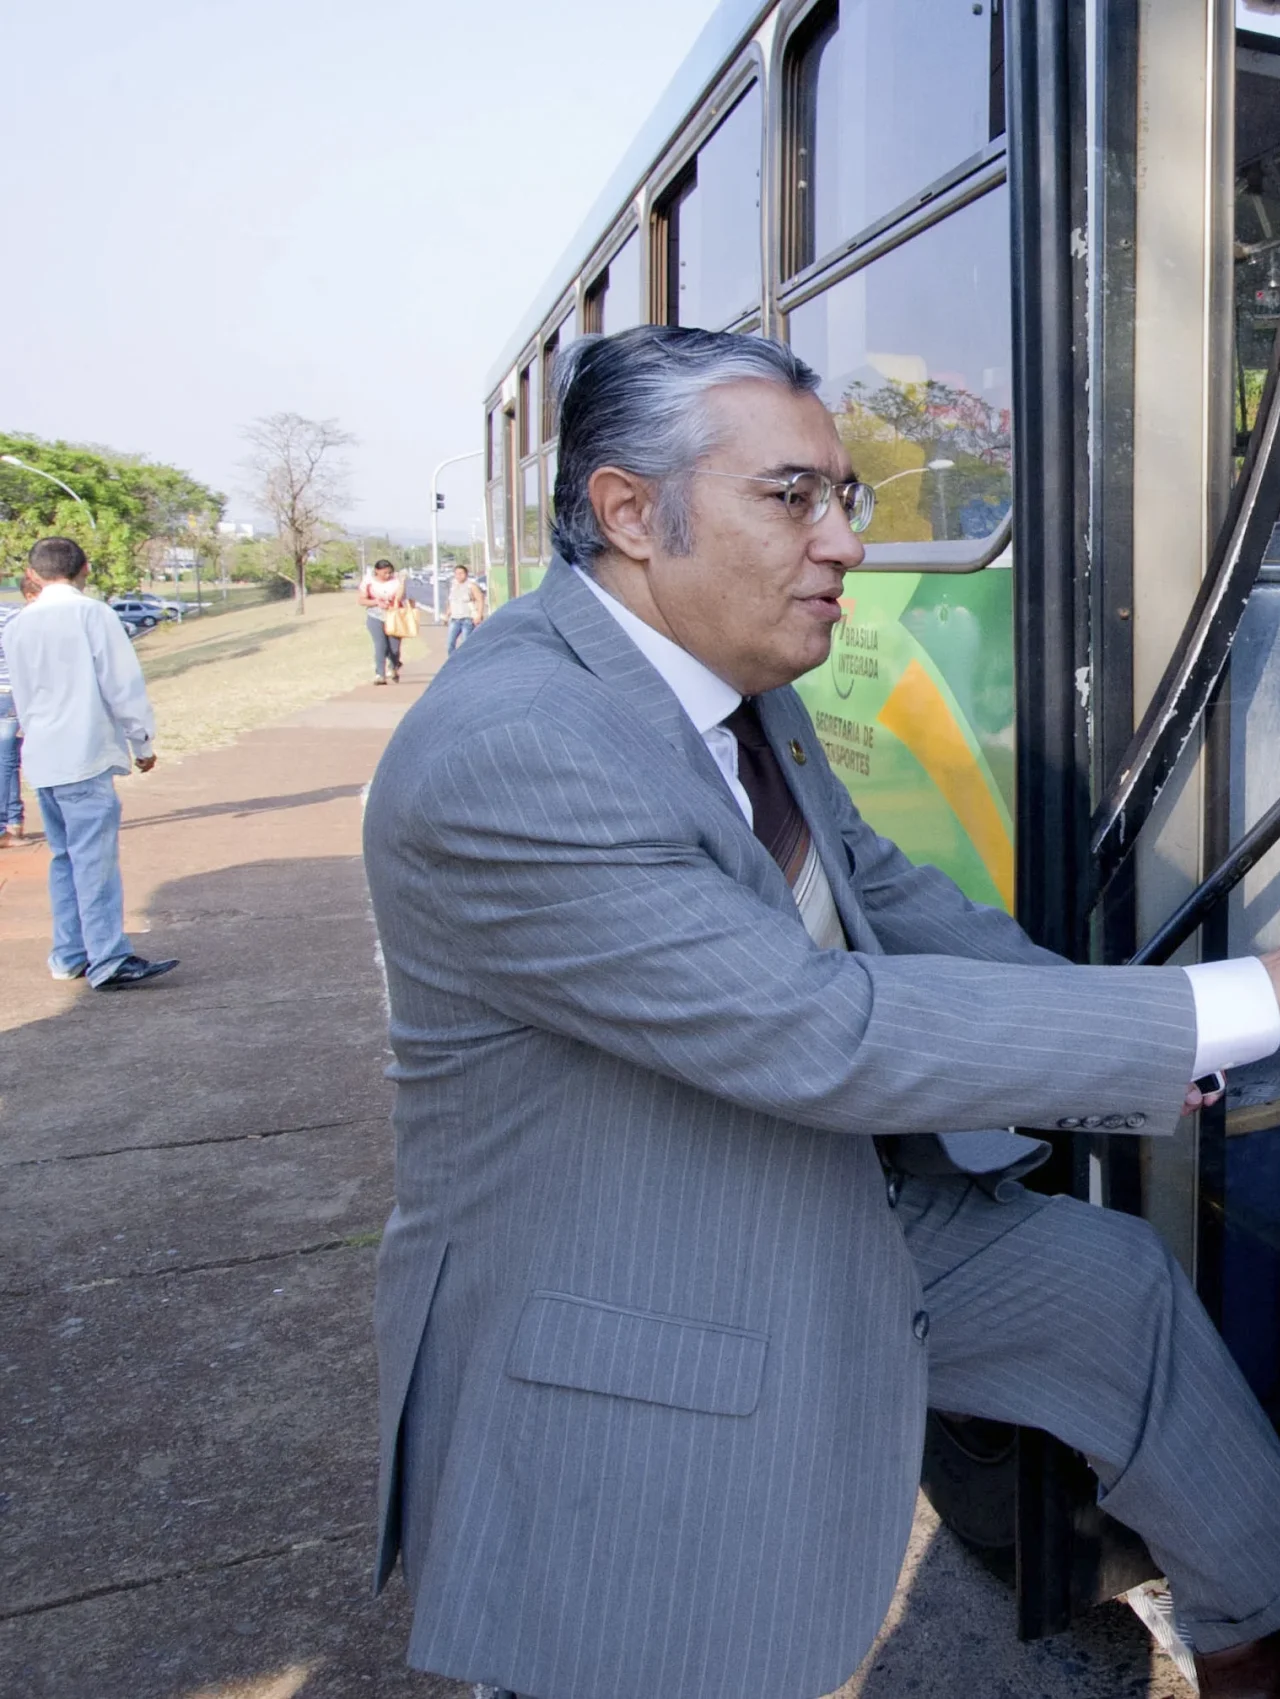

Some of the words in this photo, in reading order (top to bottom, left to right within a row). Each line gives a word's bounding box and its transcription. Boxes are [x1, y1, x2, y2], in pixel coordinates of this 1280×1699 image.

[838, 652, 879, 680] INTEGRADA
[815, 709, 860, 745] SECRETARIA
[863, 724, 874, 749] DE
[819, 738, 870, 777] ANSPORTES
